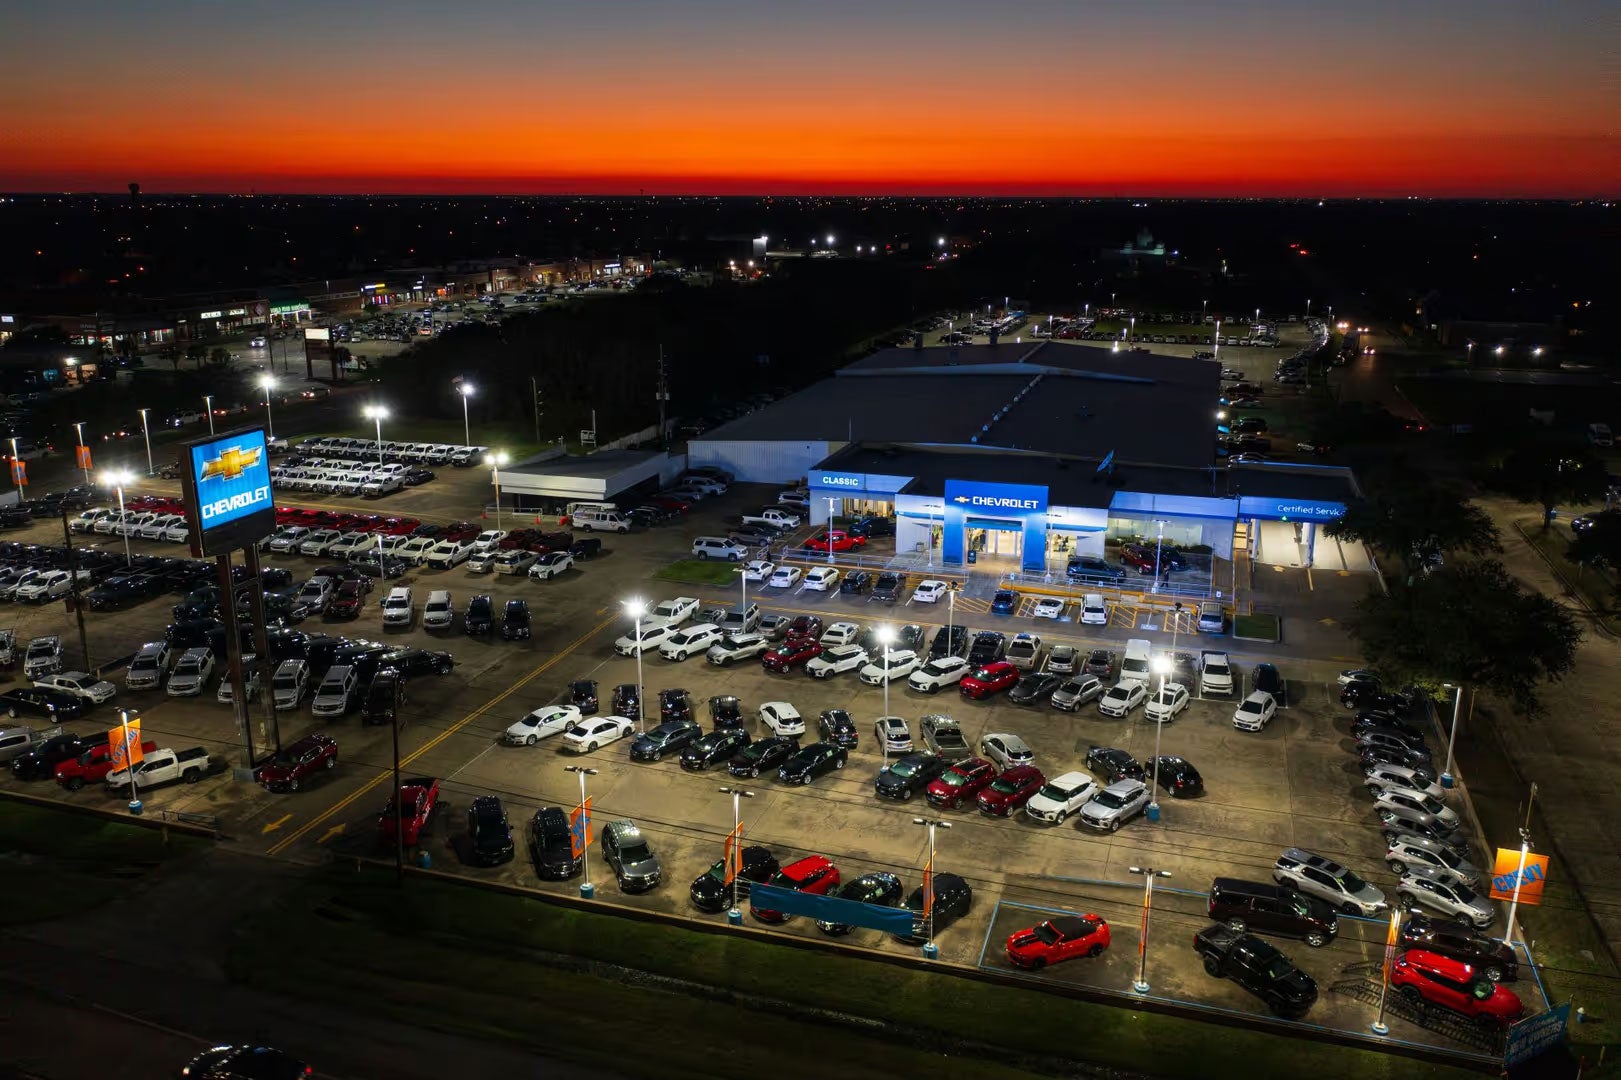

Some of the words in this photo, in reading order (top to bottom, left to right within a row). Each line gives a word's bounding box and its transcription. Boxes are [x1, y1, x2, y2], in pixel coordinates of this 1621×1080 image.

[822, 476, 859, 486] CLASSIC
[202, 486, 268, 519] CHEVROLET
[972, 495, 1039, 509] CHEVROLET
[1277, 504, 1313, 514] Certified
